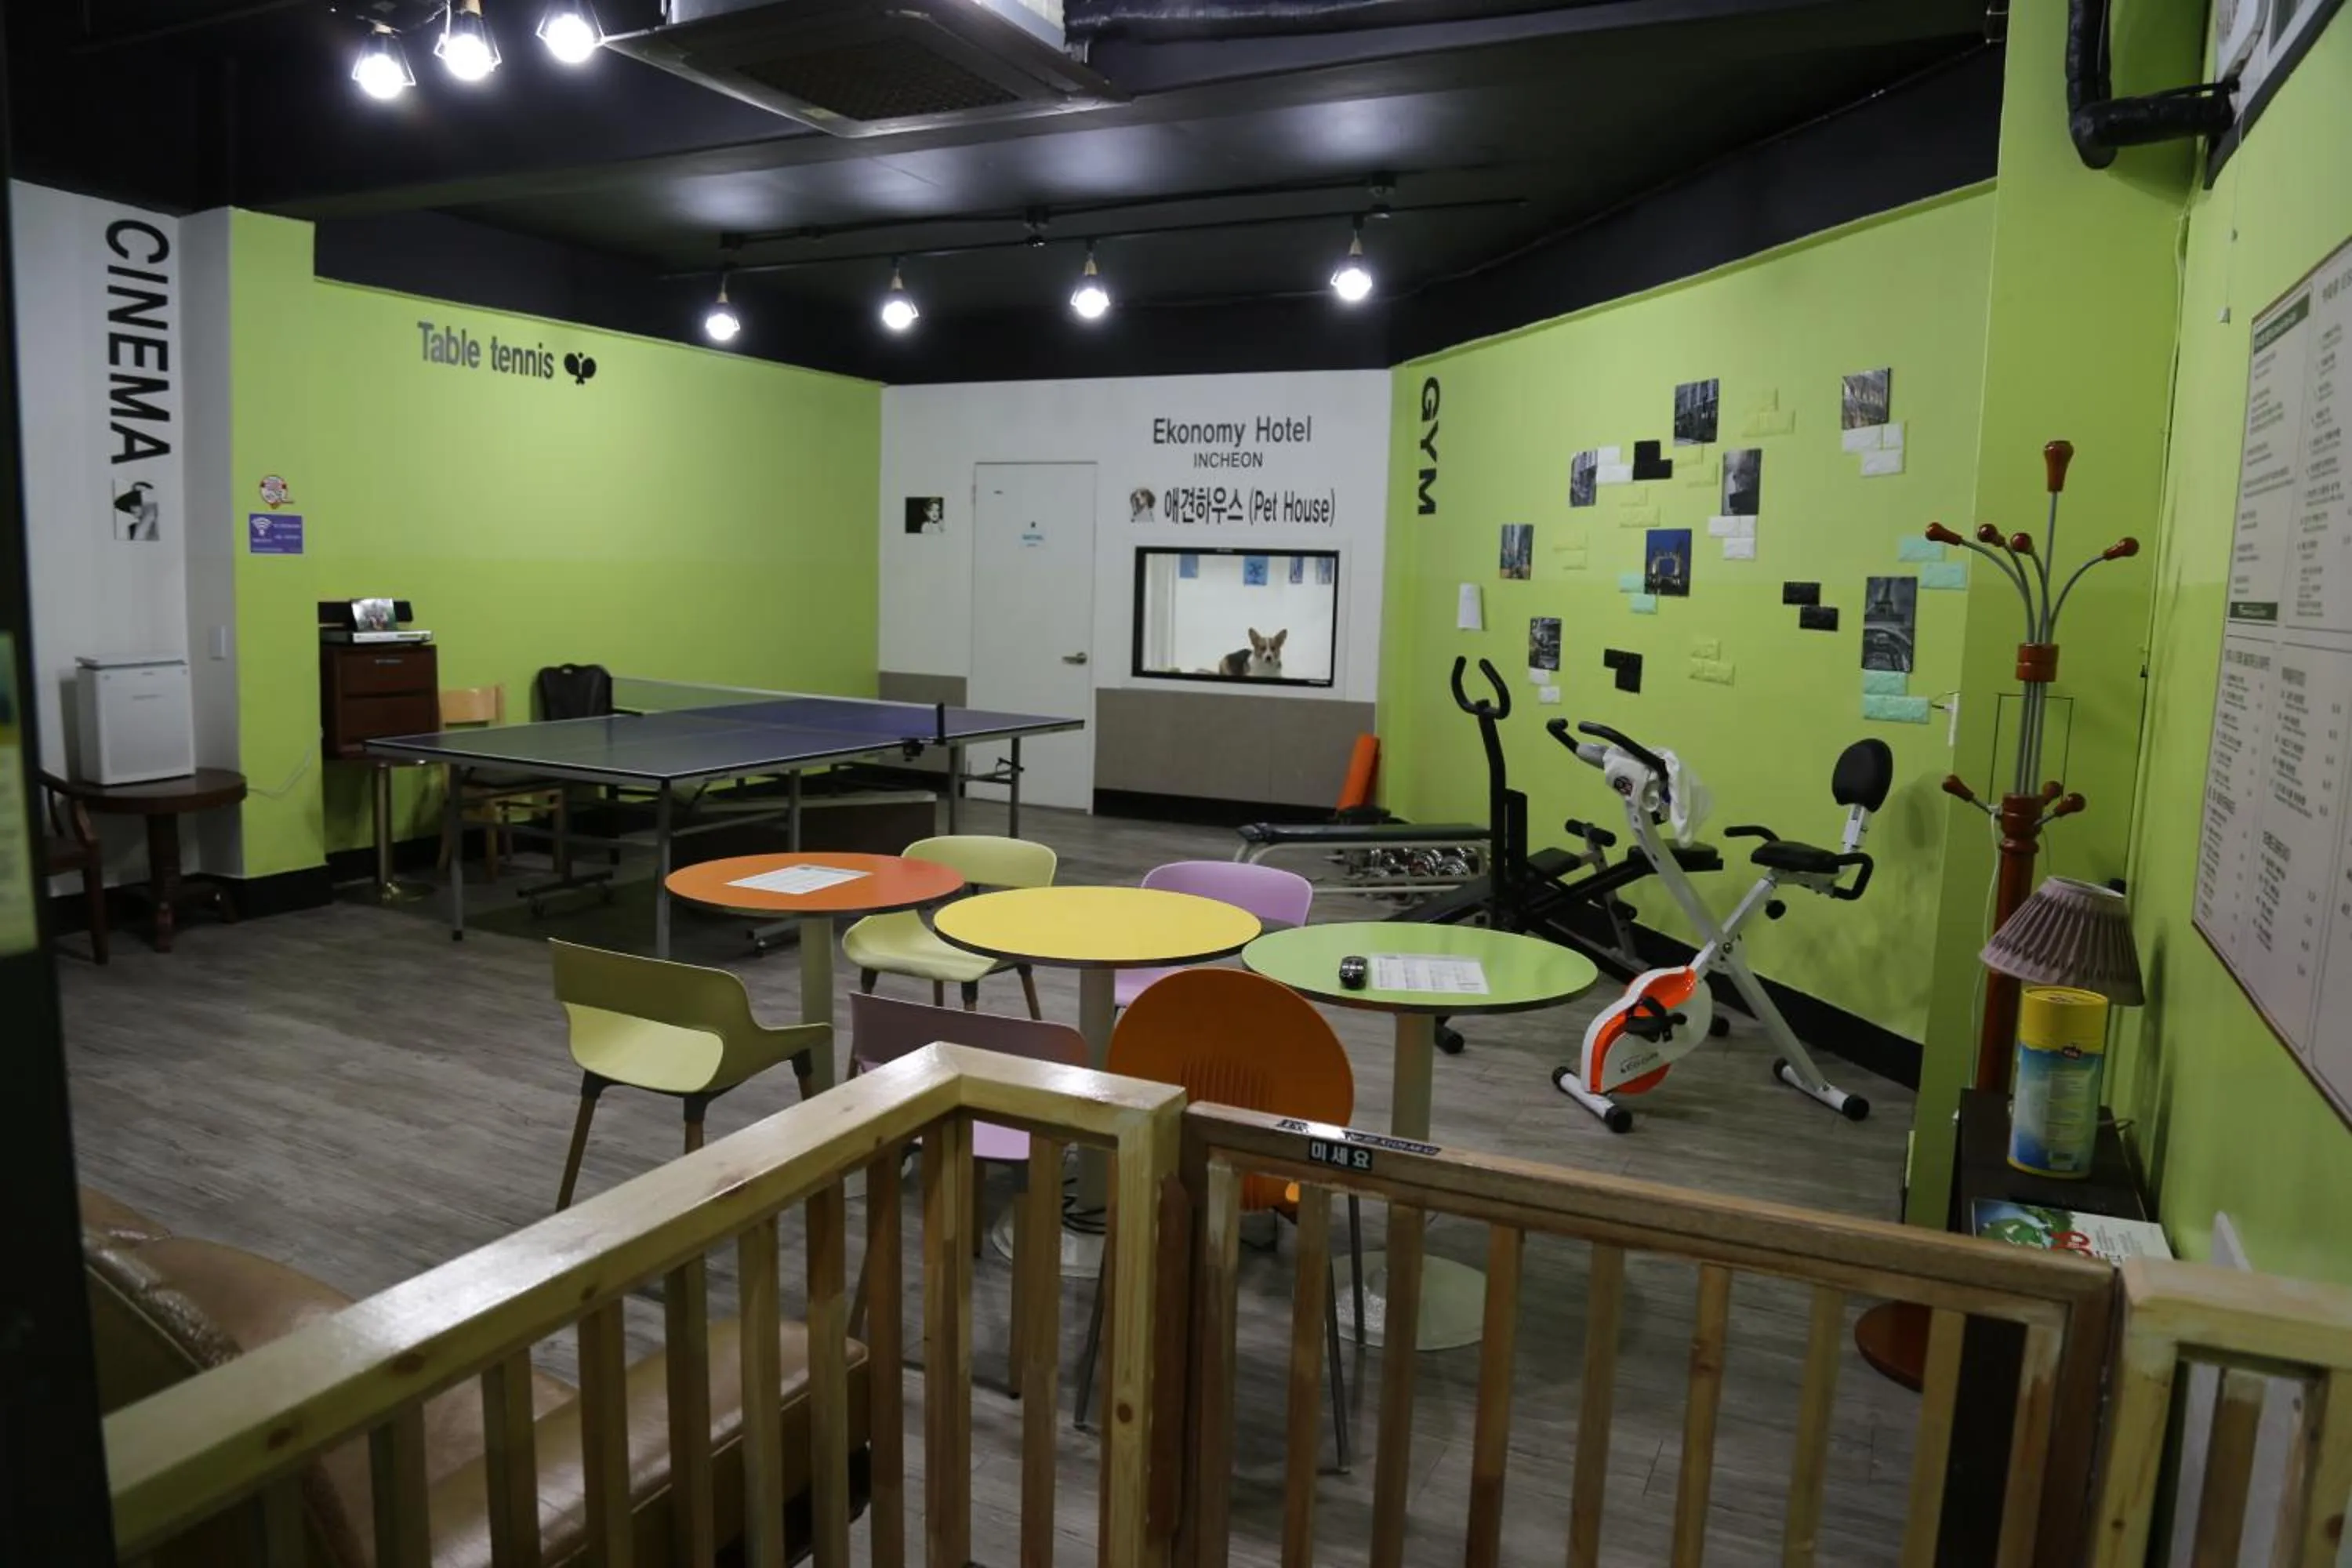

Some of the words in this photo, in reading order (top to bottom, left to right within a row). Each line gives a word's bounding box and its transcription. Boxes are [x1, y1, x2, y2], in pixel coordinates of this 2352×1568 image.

[105, 219, 171, 464] CINEMA
[417, 320, 481, 369] Table
[490, 335, 554, 379] tennis
[1153, 418, 1246, 448] Ekonomy
[1255, 415, 1312, 443] Hotel
[1417, 376, 1440, 515] GYM
[1193, 452, 1263, 468] INCHEON
[1164, 486, 1243, 524] 애견하우스
[1249, 487, 1277, 526] (Pet
[1283, 488, 1335, 527] House)
[1312, 1141, 1370, 1169] 미세요
